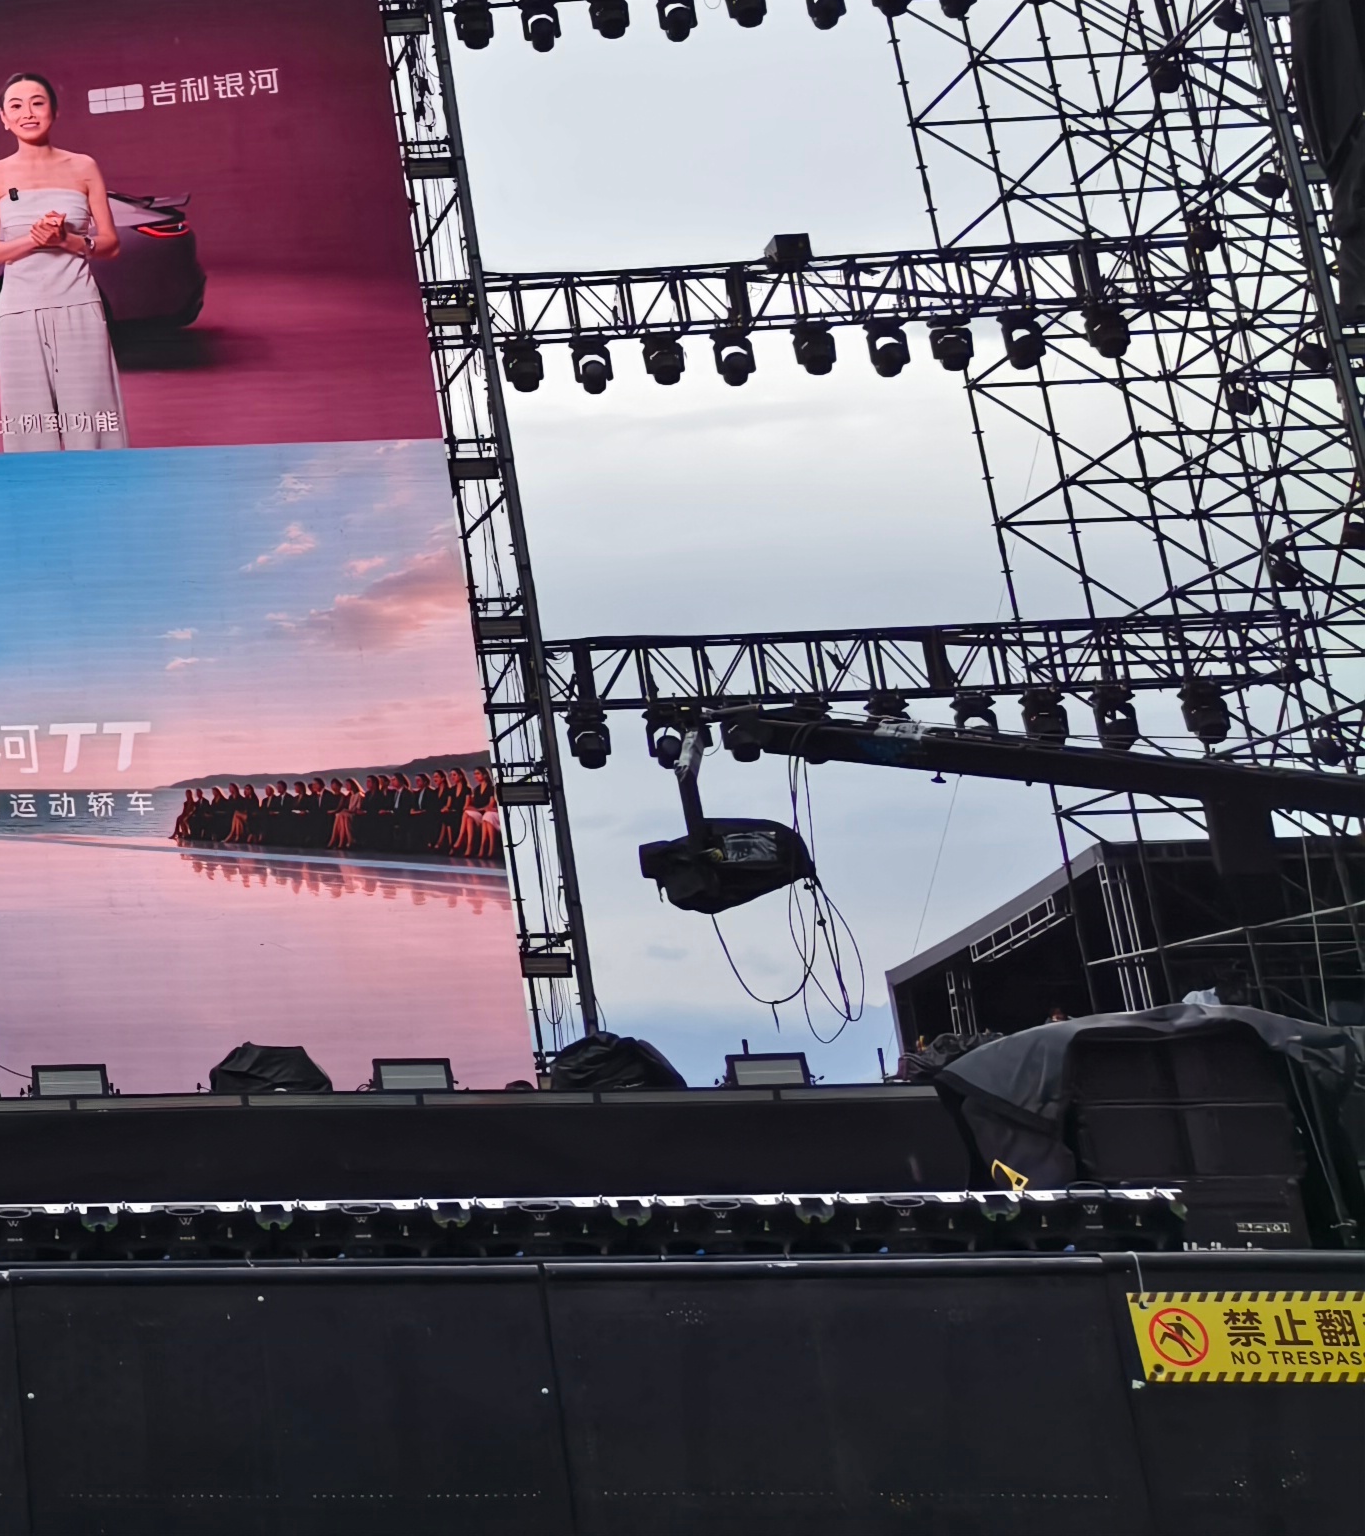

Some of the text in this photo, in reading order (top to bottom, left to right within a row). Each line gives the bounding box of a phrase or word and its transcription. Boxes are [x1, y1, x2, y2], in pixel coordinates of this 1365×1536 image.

[149, 67, 280, 106] 吉利银河
[1223, 1308, 1365, 1347] 禁止翻
[1231, 1351, 1365, 1365] NO TRESPAS
